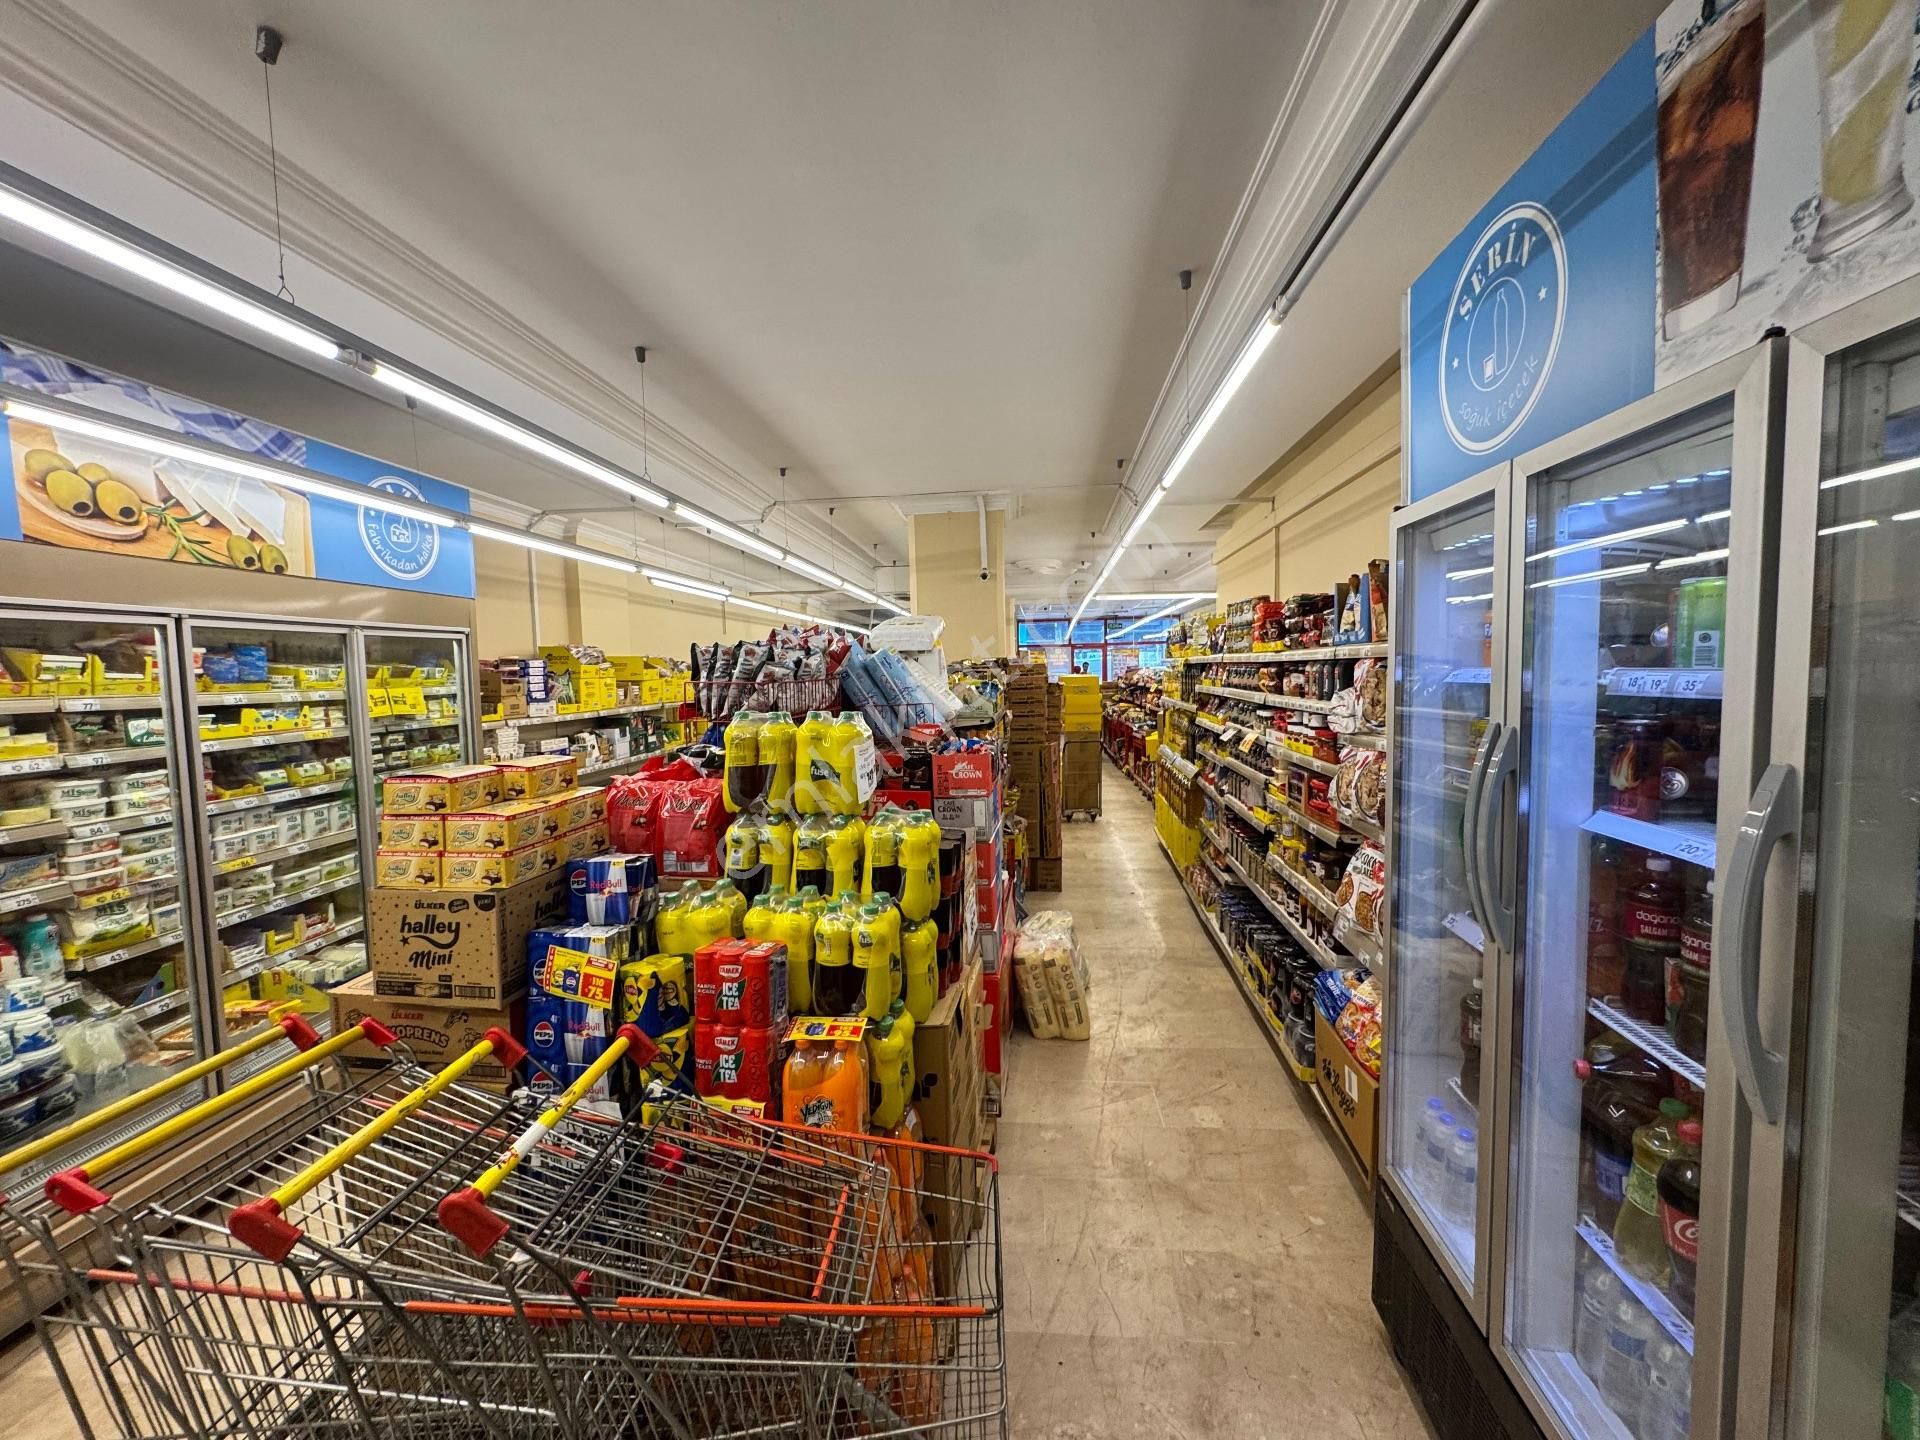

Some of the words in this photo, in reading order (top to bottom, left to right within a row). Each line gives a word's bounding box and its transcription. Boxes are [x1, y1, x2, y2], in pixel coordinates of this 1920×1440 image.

[1459, 222, 1536, 321] SERİN
[1458, 401, 1492, 432] soğuk
[1496, 355, 1539, 424] içecek
[367, 523, 418, 571] fabrikadan
[416, 535, 433, 565] halka
[1682, 680, 1696, 691] 35
[811, 765, 829, 776] fuse
[953, 770, 983, 779] CROWN
[938, 805, 962, 813] CROWN
[1680, 844, 1700, 855] 20
[414, 899, 446, 910] ÜLKER
[400, 914, 461, 949] halley
[408, 949, 454, 970] Mini
[719, 966, 741, 975] TAMEK
[592, 977, 605, 987] 110
[587, 985, 604, 1000] 75
[723, 982, 739, 996] ICE
[722, 996, 741, 1011] TEA
[715, 1038, 737, 1047] TAMEK
[719, 1054, 736, 1068] ICE
[719, 1070, 738, 1083] TEA
